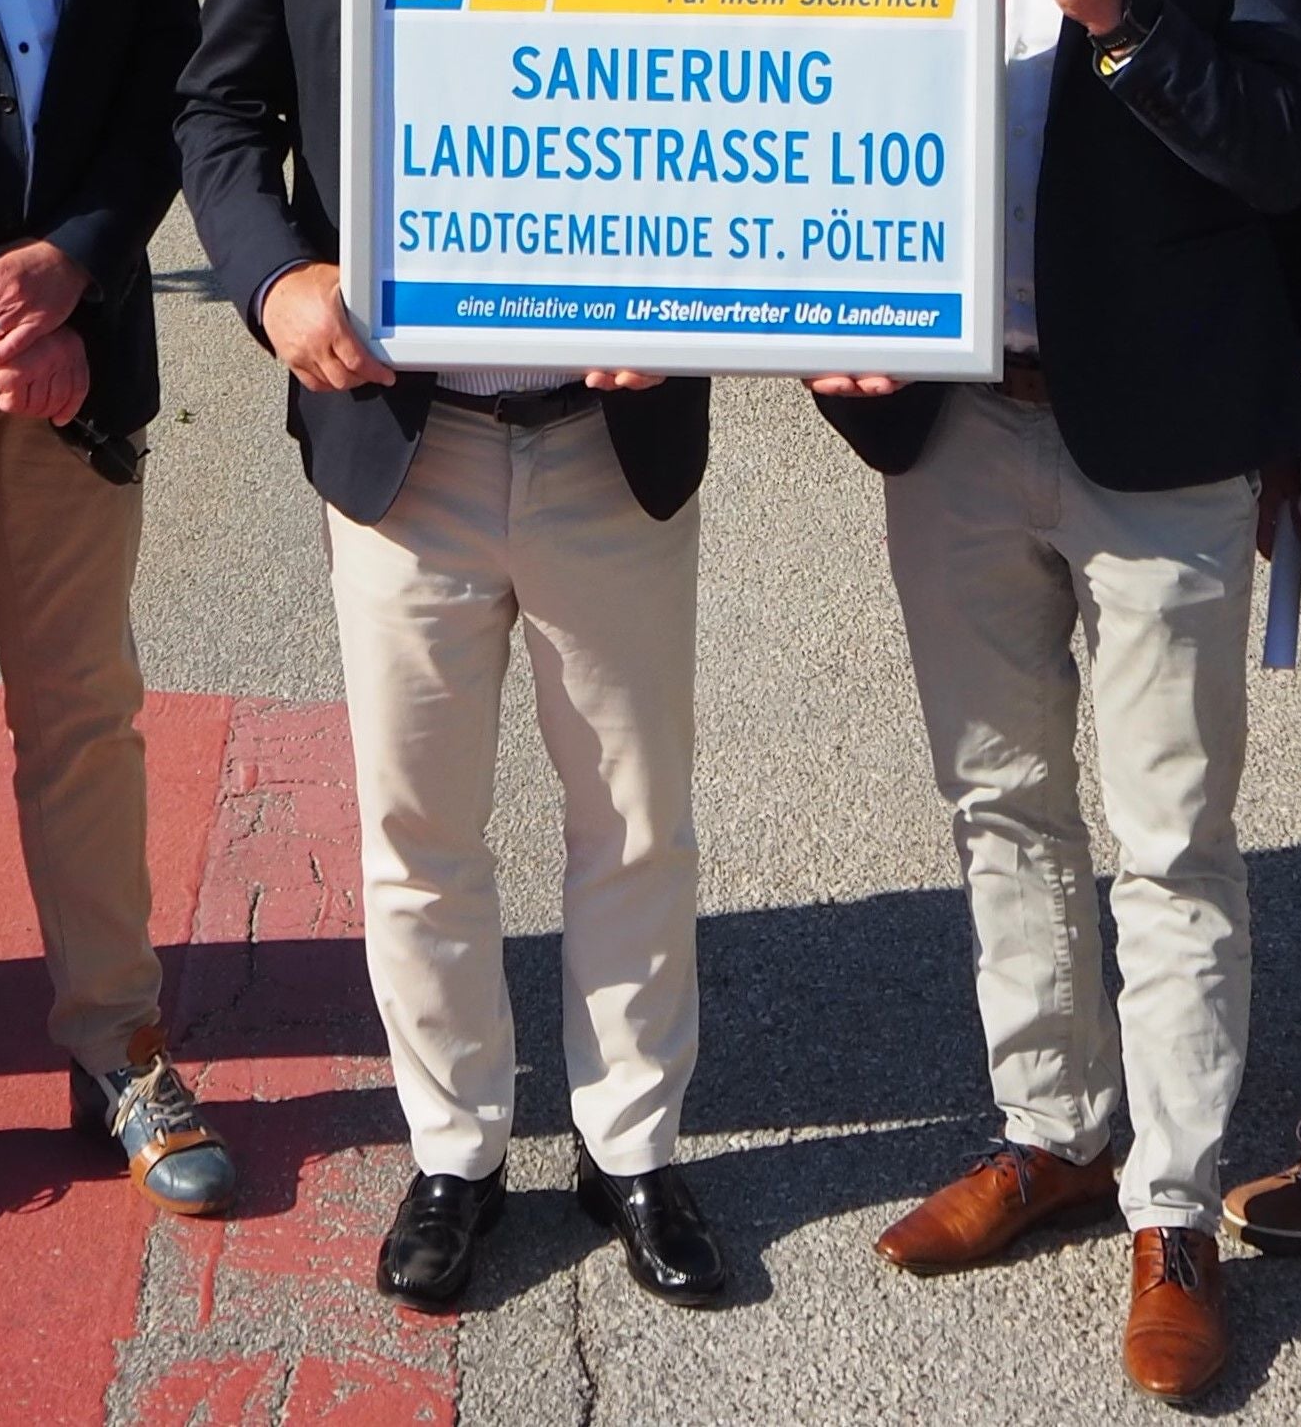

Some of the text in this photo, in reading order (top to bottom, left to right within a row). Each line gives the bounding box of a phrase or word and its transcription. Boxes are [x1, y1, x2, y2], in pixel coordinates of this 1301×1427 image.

[511, 46, 833, 105] SANIERUNG
[403, 124, 945, 187] LANDESSTRASSE L100
[399, 209, 946, 263] STADTGEMEINDE ST. PÖLTEN
[457, 296, 940, 327] eine Initiative von LH-Stellvertreter Udo Landbauer
